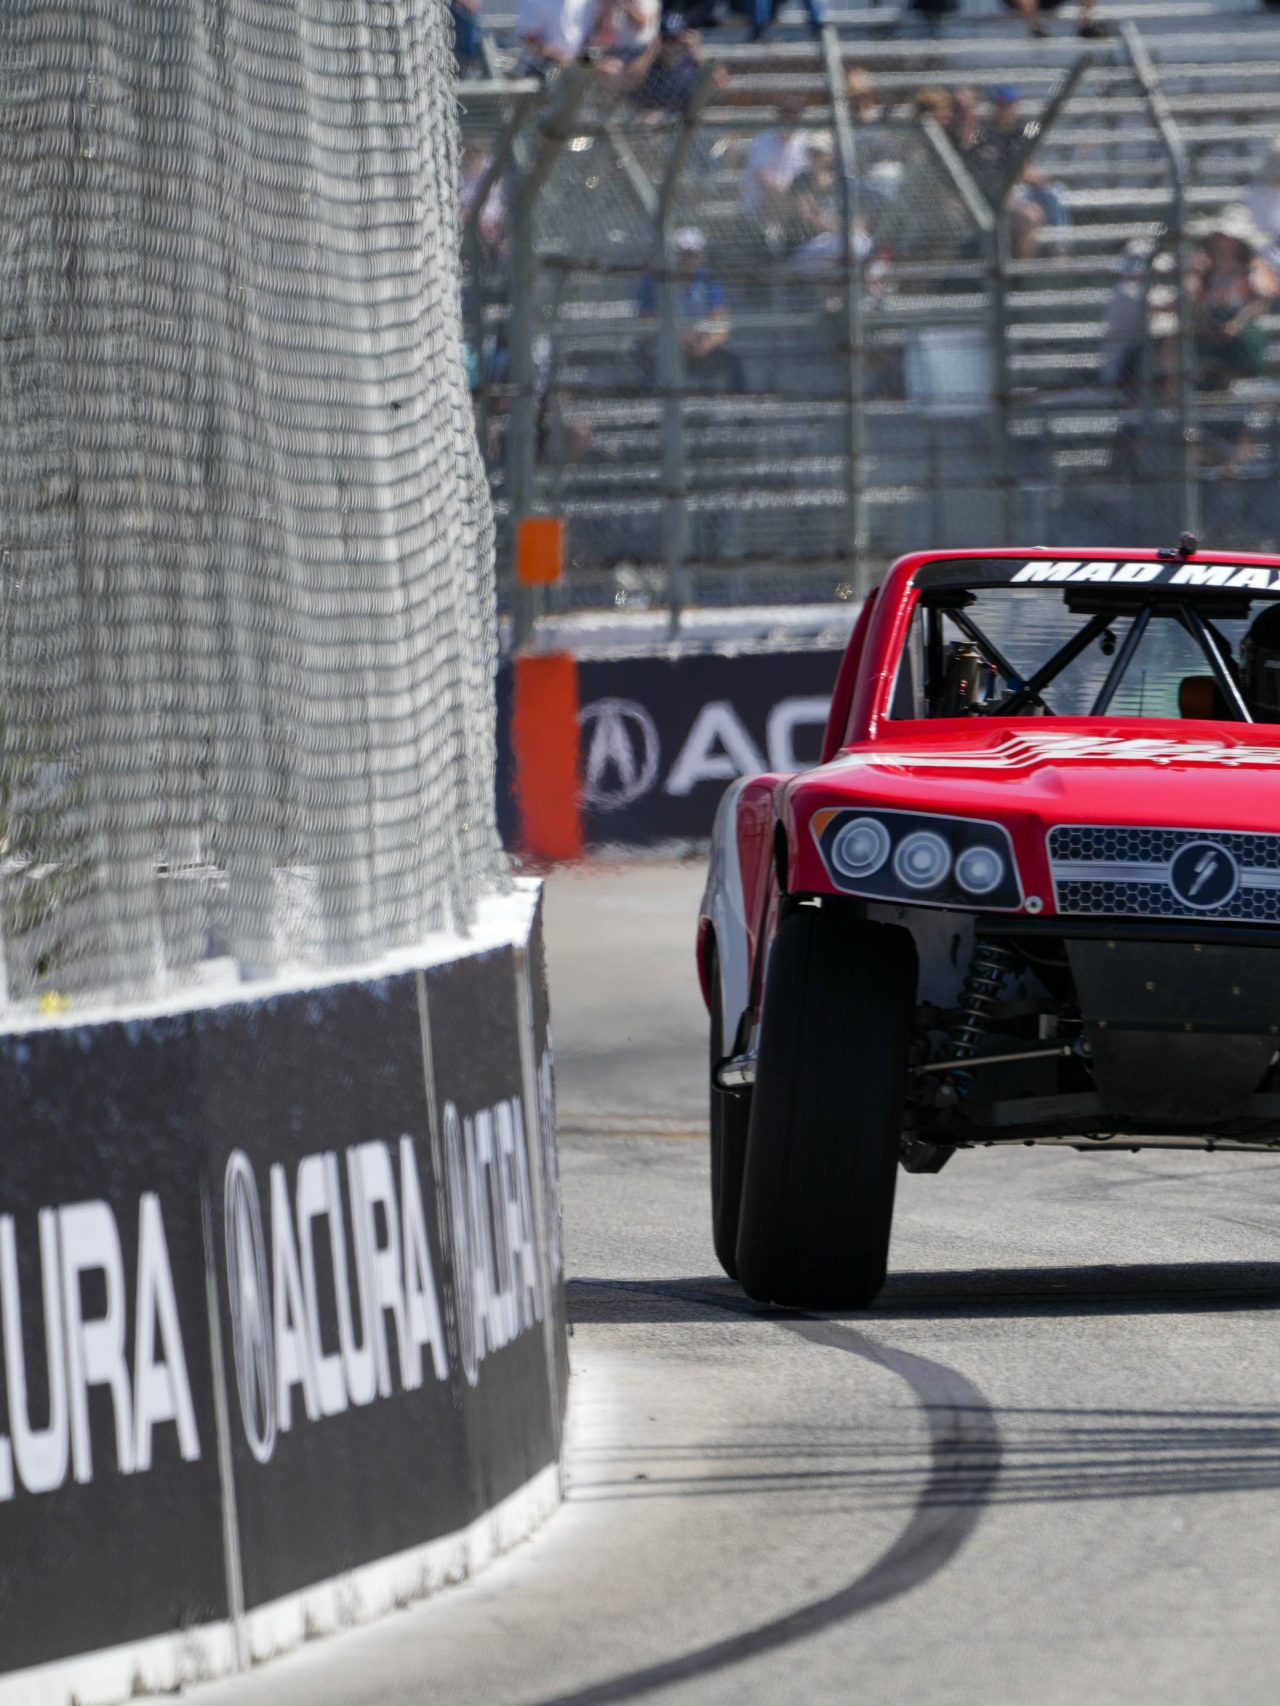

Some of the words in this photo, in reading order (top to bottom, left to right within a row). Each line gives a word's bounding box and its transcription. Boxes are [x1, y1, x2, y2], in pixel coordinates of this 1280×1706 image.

[1010, 561, 1164, 584] MAD
[0, 1191, 201, 1498] URA
[270, 1134, 449, 1434] ACURA
